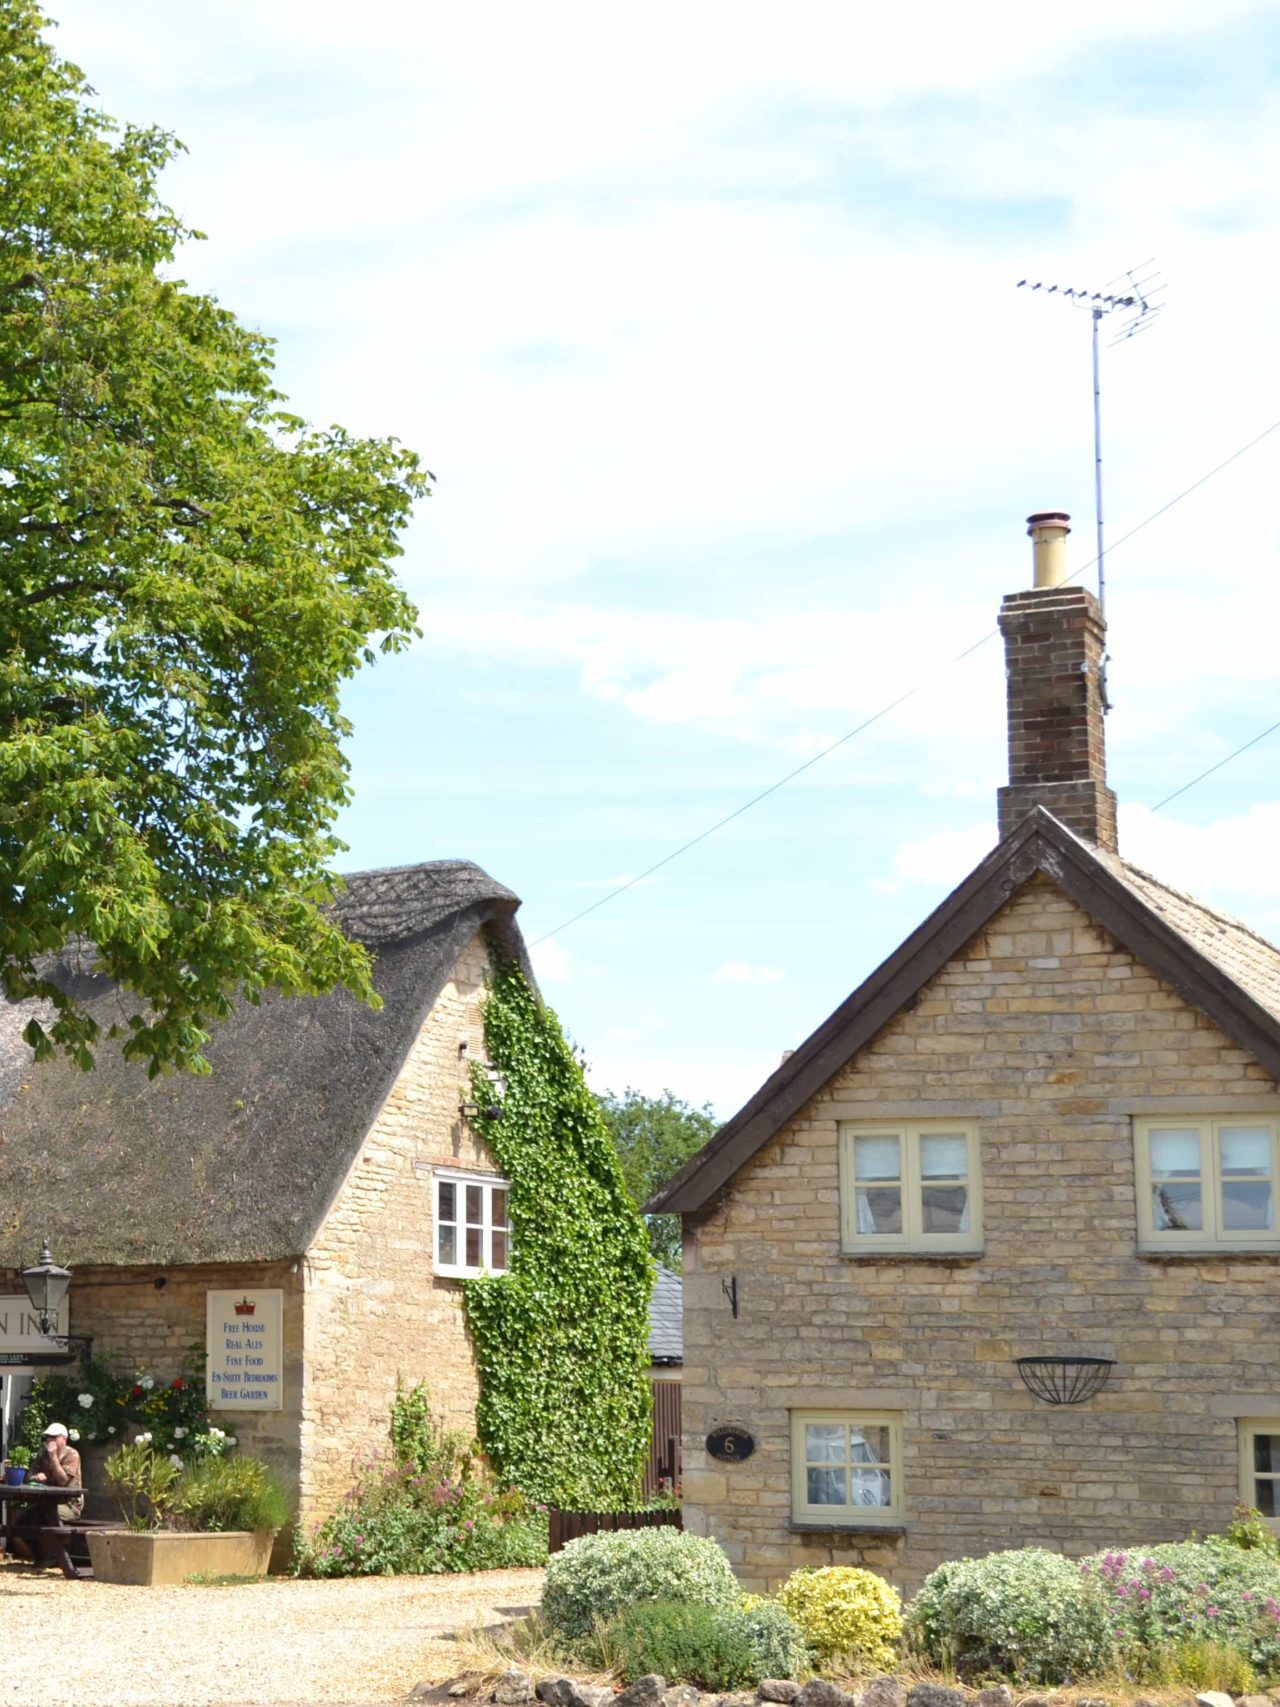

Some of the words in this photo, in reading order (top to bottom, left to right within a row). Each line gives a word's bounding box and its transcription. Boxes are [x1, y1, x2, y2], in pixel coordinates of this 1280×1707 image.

[19, 1312, 60, 1335] INN
[223, 1322, 240, 1333] FREE
[242, 1322, 265, 1333] HOUSE
[225, 1338, 242, 1349] REAL
[245, 1338, 263, 1349] ALES
[226, 1355, 242, 1366] FINE
[245, 1355, 264, 1366] FOOD
[243, 1372, 278, 1383] BEDROOMS
[221, 1388, 238, 1399] BEER
[240, 1388, 268, 1400] GARDEN
[724, 1436, 735, 1453] 6
